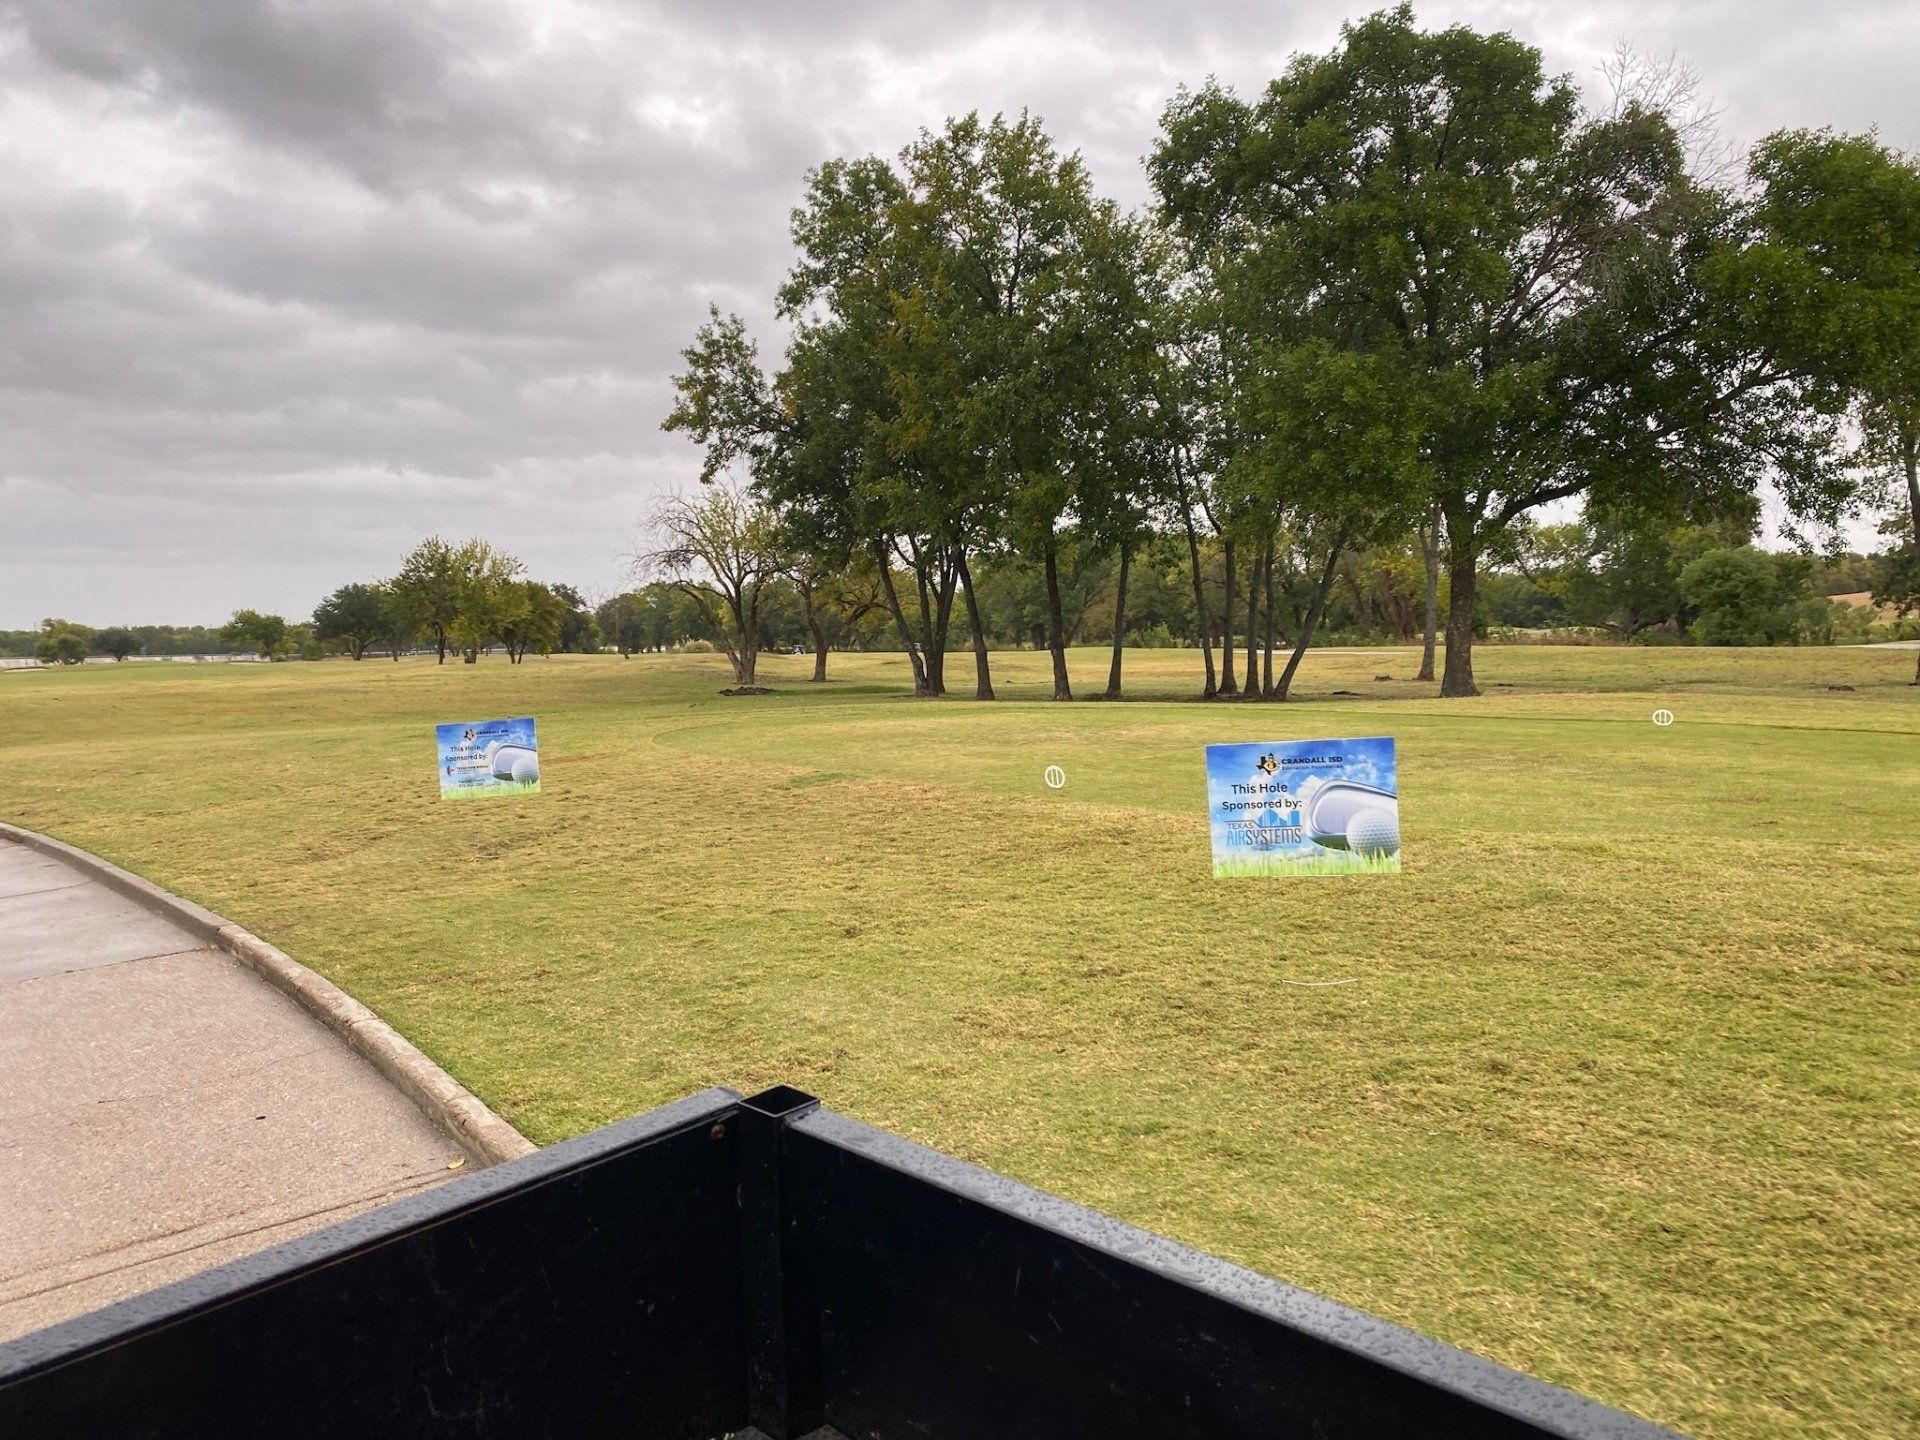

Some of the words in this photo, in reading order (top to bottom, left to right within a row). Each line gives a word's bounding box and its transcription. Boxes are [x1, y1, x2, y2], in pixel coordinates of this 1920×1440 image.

[445, 753, 478, 763] Sponsored
[1281, 756, 1327, 765] CRANDALL
[1328, 755, 1343, 763] ISD
[1231, 783, 1257, 795] This
[1259, 782, 1288, 793] Hole
[1222, 799, 1282, 812] Sponsored
[1284, 798, 1303, 810] by:
[1227, 822, 1254, 830] TEXAS
